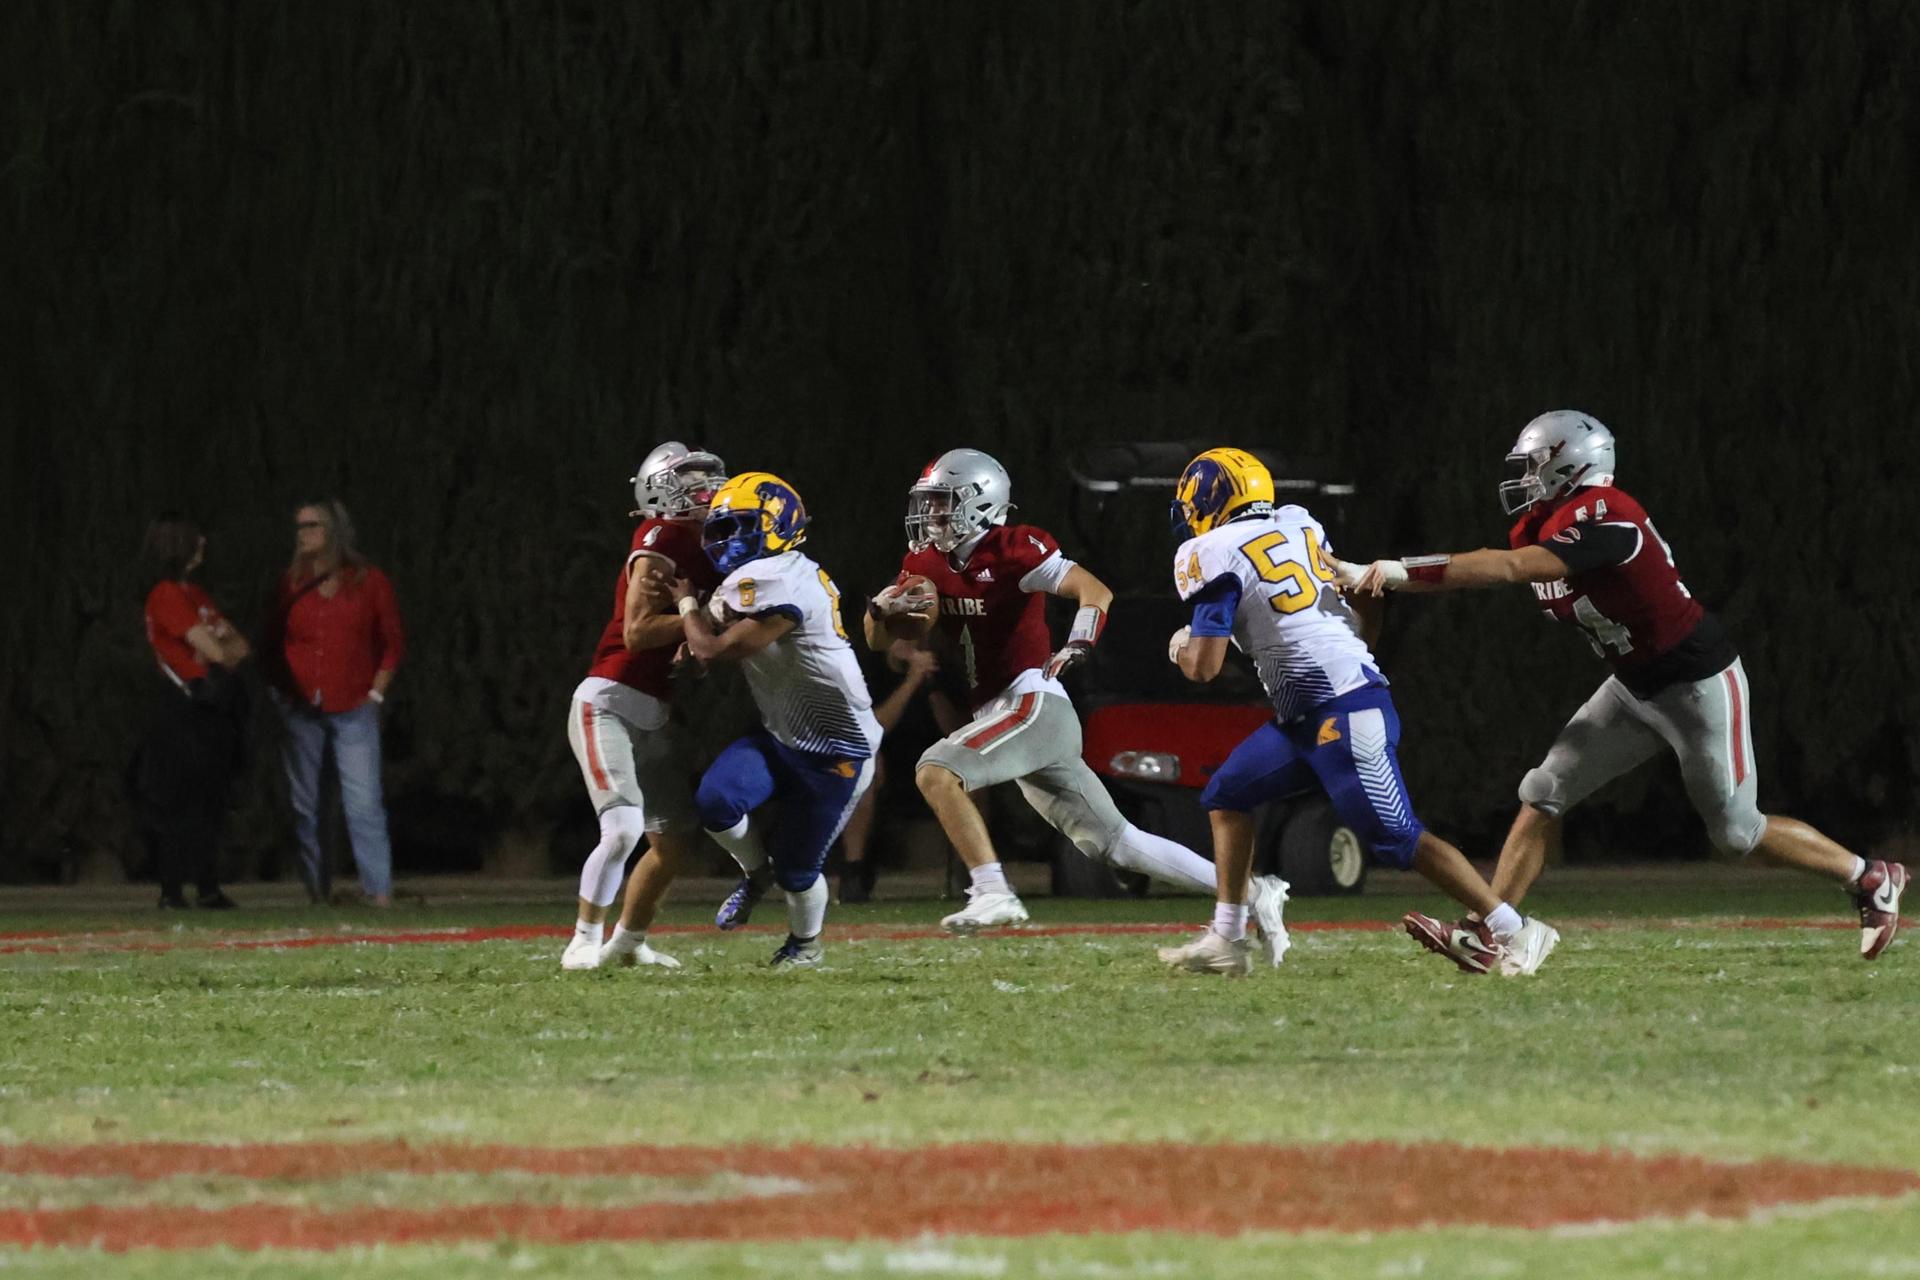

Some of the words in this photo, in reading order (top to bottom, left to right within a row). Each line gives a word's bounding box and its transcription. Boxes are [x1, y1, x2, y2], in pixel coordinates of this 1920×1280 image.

[1028, 535, 1048, 554] 1
[1175, 552, 1203, 592] 54
[1238, 527, 1336, 615] 54
[738, 578, 756, 607] 6
